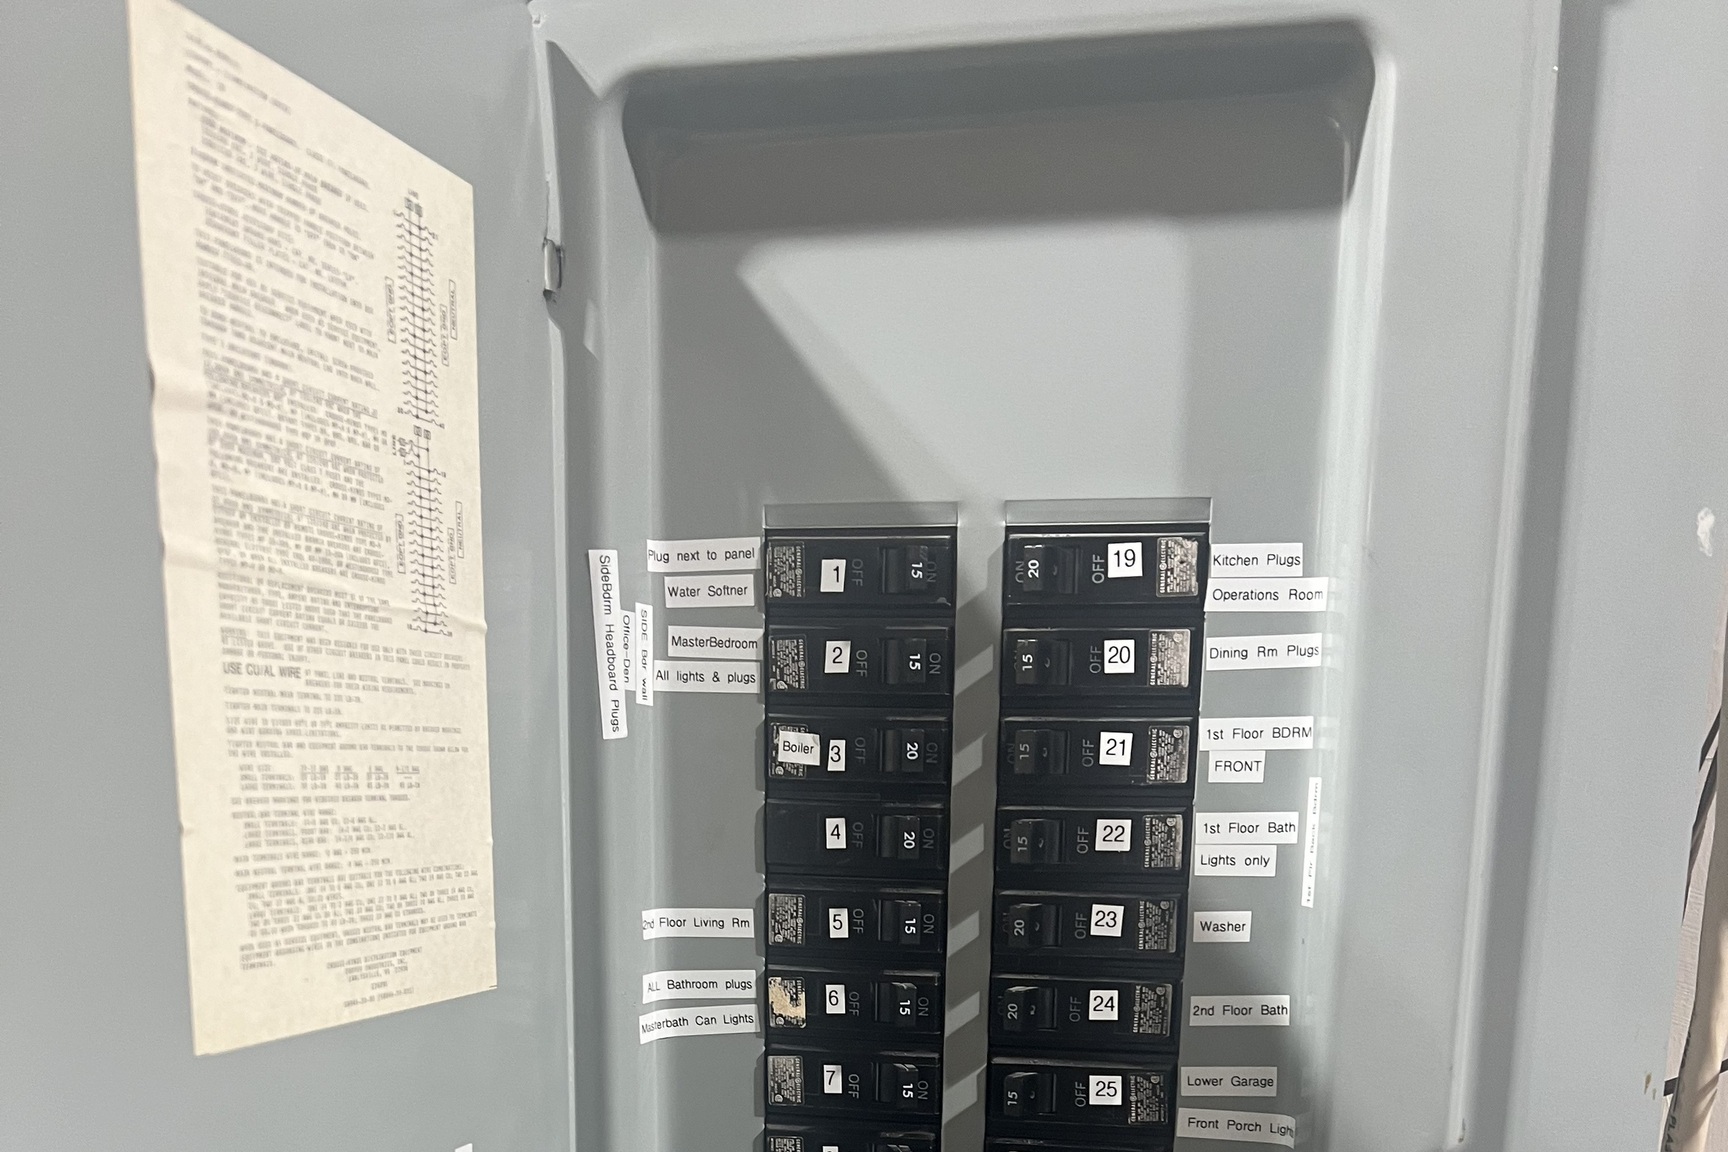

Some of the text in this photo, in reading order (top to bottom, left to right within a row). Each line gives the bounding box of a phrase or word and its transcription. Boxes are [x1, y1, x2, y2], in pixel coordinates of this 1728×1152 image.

[648, 548, 755, 563] Plug next to panel
[1114, 549, 1135, 568] 19
[1213, 554, 1301, 568] Kitchen Plugs
[834, 567, 839, 582] 1
[911, 562, 922, 579] 15
[668, 584, 748, 597] Water Softner
[1212, 589, 1323, 602] Operations Room
[599, 555, 619, 732] SideBdrm Headboard Plugs
[672, 636, 758, 649] MasterBedroom
[832, 648, 841, 663] 2
[1108, 647, 1130, 663] 20
[1210, 645, 1319, 659] Dining Rm Plugs
[909, 654, 920, 670] 15
[223, 662, 243, 677] USE
[279, 665, 301, 679] WIRE
[656, 671, 756, 684] All lights & plugs
[1207, 727, 1312, 740] 1st Floor BDRM
[783, 741, 813, 754] Boiler
[831, 747, 840, 762] 3
[1106, 740, 1126, 756] 21
[1215, 760, 1262, 772] FRONT
[831, 824, 840, 839] 4
[1103, 826, 1124, 842] 22
[1204, 822, 1296, 833] 1st Floor Bath
[1201, 854, 1270, 868] Lights only
[642, 918, 749, 929] 2nd Floor Living Rm
[832, 915, 843, 930] 5
[1095, 911, 1117, 928] 23
[1200, 921, 1246, 932] Washer
[648, 979, 752, 992] ALL Bathroom plugs
[829, 991, 838, 1006] 6
[1093, 996, 1114, 1011] 24
[1193, 1004, 1288, 1016] 2nd Floor Bath
[642, 1013, 754, 1033] Masterbath Can Lights
[826, 1071, 834, 1085] 7
[1188, 1076, 1273, 1089] Lower Garage
[1096, 1081, 1117, 1097] 25
[1188, 1118, 1219, 1129] Front
[1227, 1120, 1262, 1132] Porch
